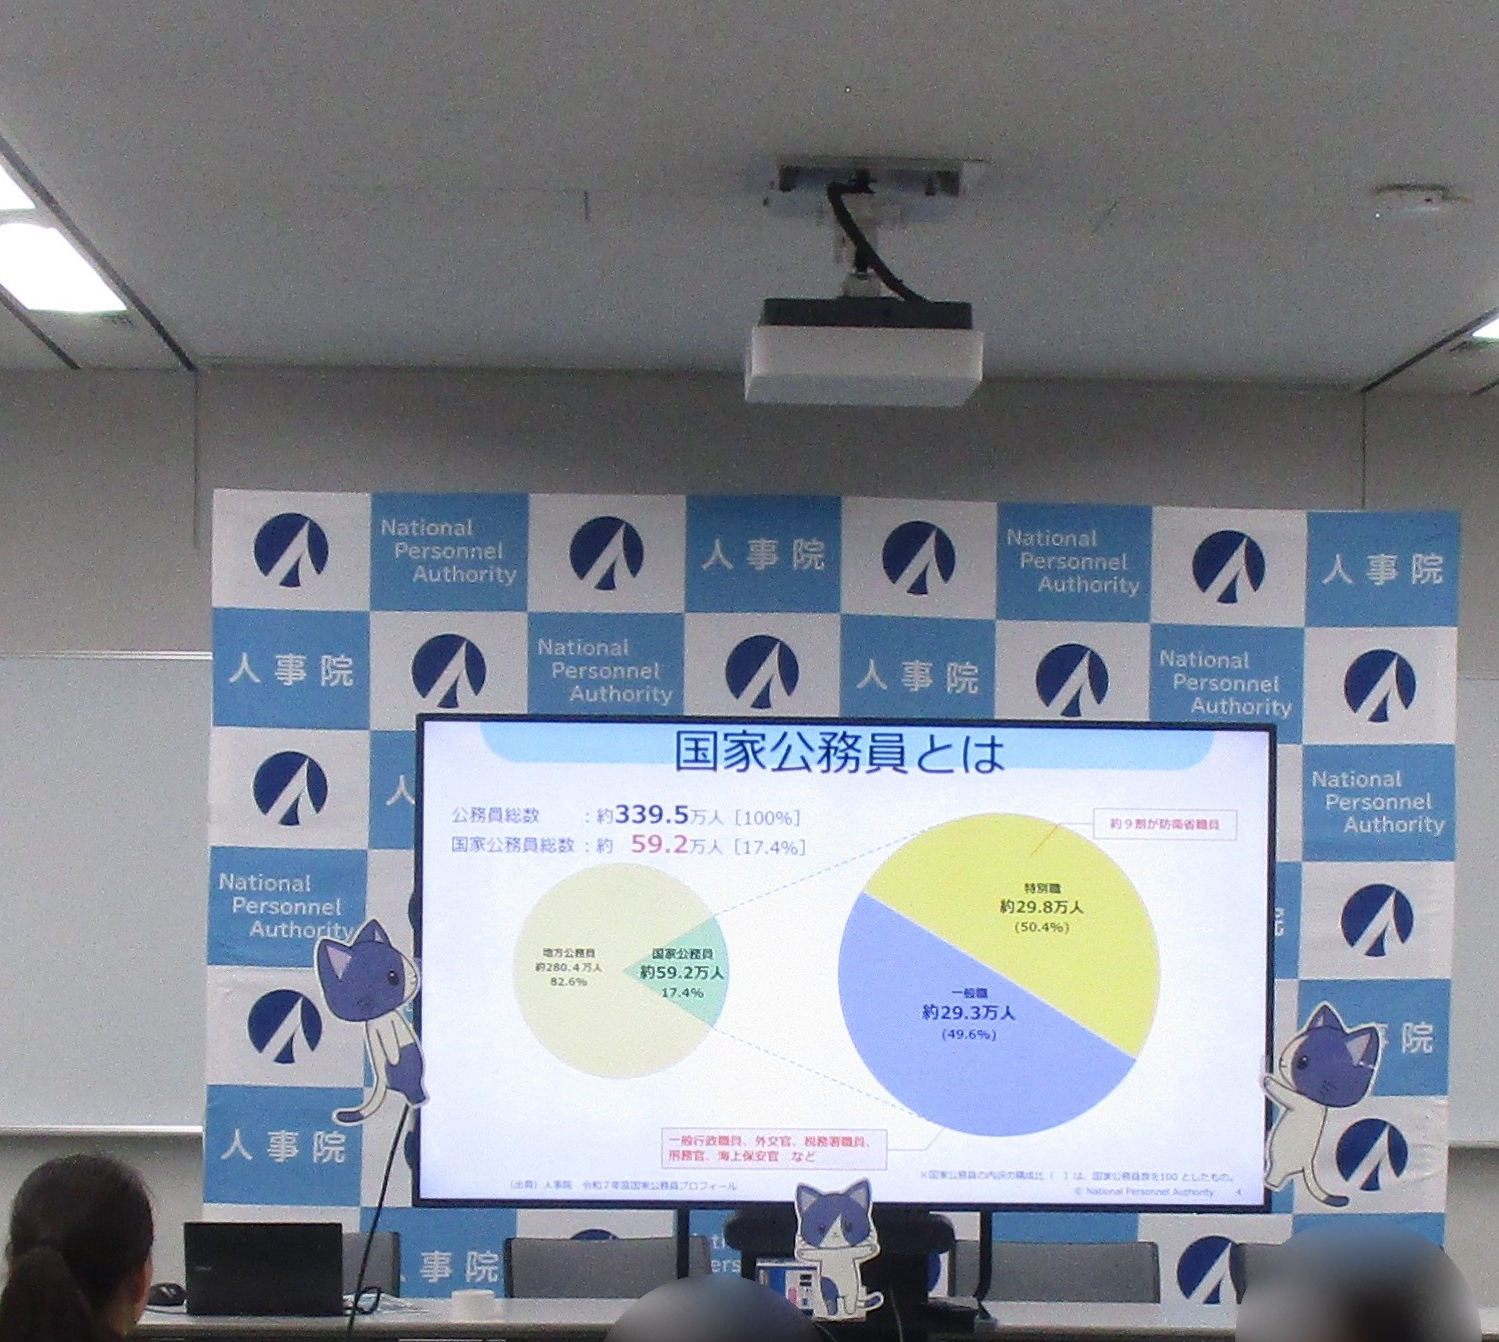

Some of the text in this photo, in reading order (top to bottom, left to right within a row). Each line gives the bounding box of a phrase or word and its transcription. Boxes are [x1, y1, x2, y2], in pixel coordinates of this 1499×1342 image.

[381, 519, 472, 537] National
[1007, 528, 1097, 547] National
[395, 541, 503, 560] Personnel
[702, 537, 825, 571] 人事院
[1020, 551, 1127, 570] Personnel
[1322, 552, 1444, 586] 人事院
[413, 564, 517, 586] Authority
[1038, 575, 1140, 598] Authority
[538, 638, 628, 657] National
[1160, 650, 1249, 669] National
[229, 652, 354, 687] 人事院
[552, 661, 660, 680] Personnel
[856, 659, 979, 694] 人事院
[1174, 673, 1279, 692] Personnel
[569, 684, 673, 706] Authority
[1191, 696, 1293, 718] Authority
[676, 729, 1005, 774] 国家公務員とは
[1312, 770, 1401, 788] National
[1326, 792, 1432, 811] Personnel
[452, 806, 540, 823] 公務員総数
[1344, 815, 1445, 836] Authority
[219, 873, 311, 892] National
[1024, 883, 1061, 894] 特別職
[233, 896, 341, 915] Personnel
[1000, 899, 1084, 914] 約29.8万人
[250, 919, 354, 942] Authority
[1014, 921, 1070, 934] (50.4%)
[652, 948, 714, 960] 国家公務員
[640, 965, 725, 981] 約59.2万人
[662, 988, 705, 998] 17.4%
[922, 1003, 1016, 1021] 約29.3万人
[942, 1029, 997, 1041] (49.6%)
[221, 1129, 347, 1163] 人事院
